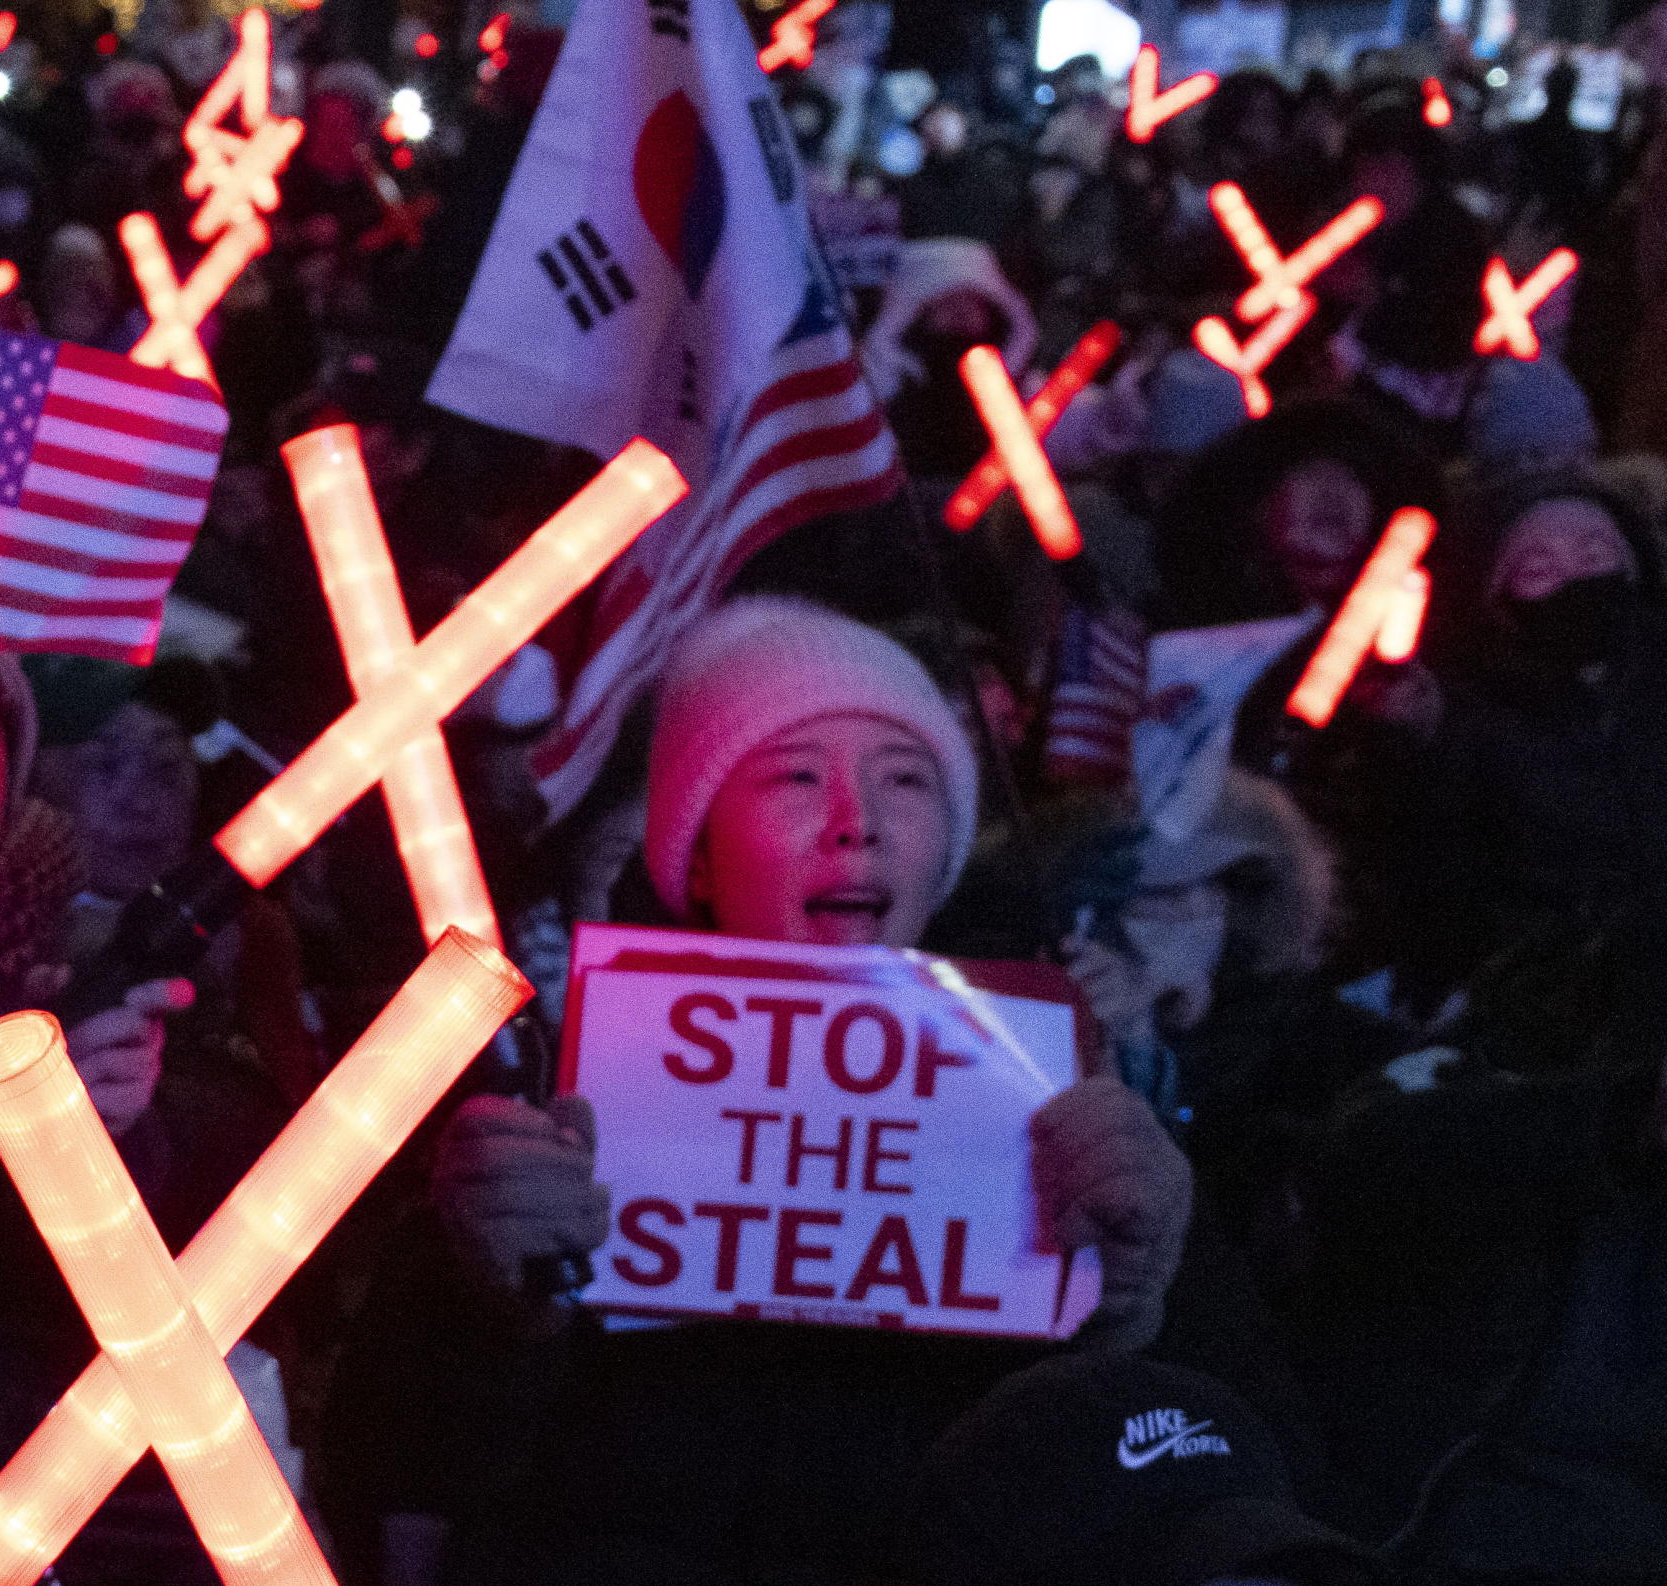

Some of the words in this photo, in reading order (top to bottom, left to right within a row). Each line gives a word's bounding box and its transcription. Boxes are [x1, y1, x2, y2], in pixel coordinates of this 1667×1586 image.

[721, 1109, 920, 1195] THE
[612, 1198, 1000, 1312] STEAL
[1124, 1407, 1187, 1447] NIKE
